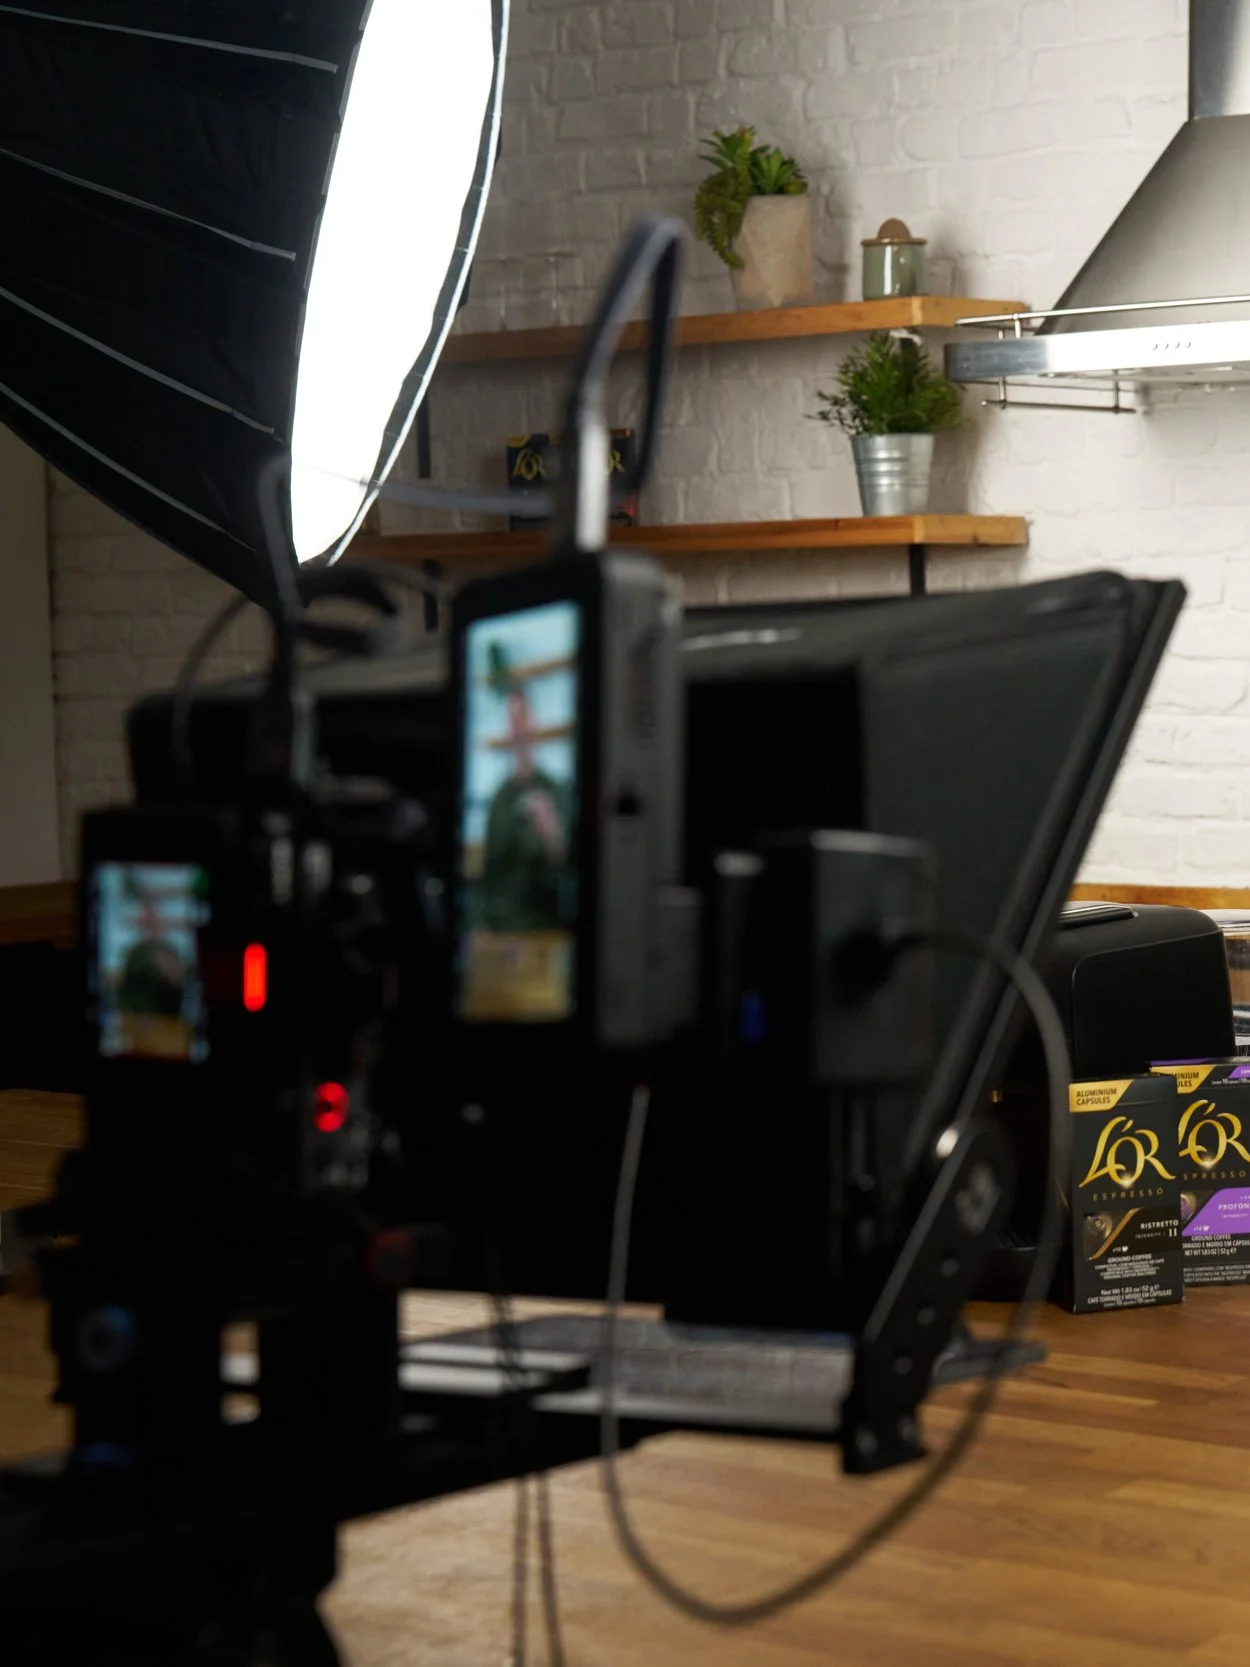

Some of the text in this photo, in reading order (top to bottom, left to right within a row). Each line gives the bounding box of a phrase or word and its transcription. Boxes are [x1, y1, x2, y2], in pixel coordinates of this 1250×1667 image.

[1076, 1088, 1117, 1098] ALUMINIUM
[1076, 1096, 1111, 1106] CAPSULES
[1078, 1116, 1177, 1188] L'OR
[1183, 1170, 1246, 1181] SPRESSO
[1092, 1187, 1164, 1201] ESPRESSO
[1140, 1219, 1179, 1230] RISTRETTO
[1168, 1228, 1177, 1237] 11
[1213, 1233, 1231, 1241] COFFEE
[1107, 1253, 1153, 1263] GROUND COFFEE
